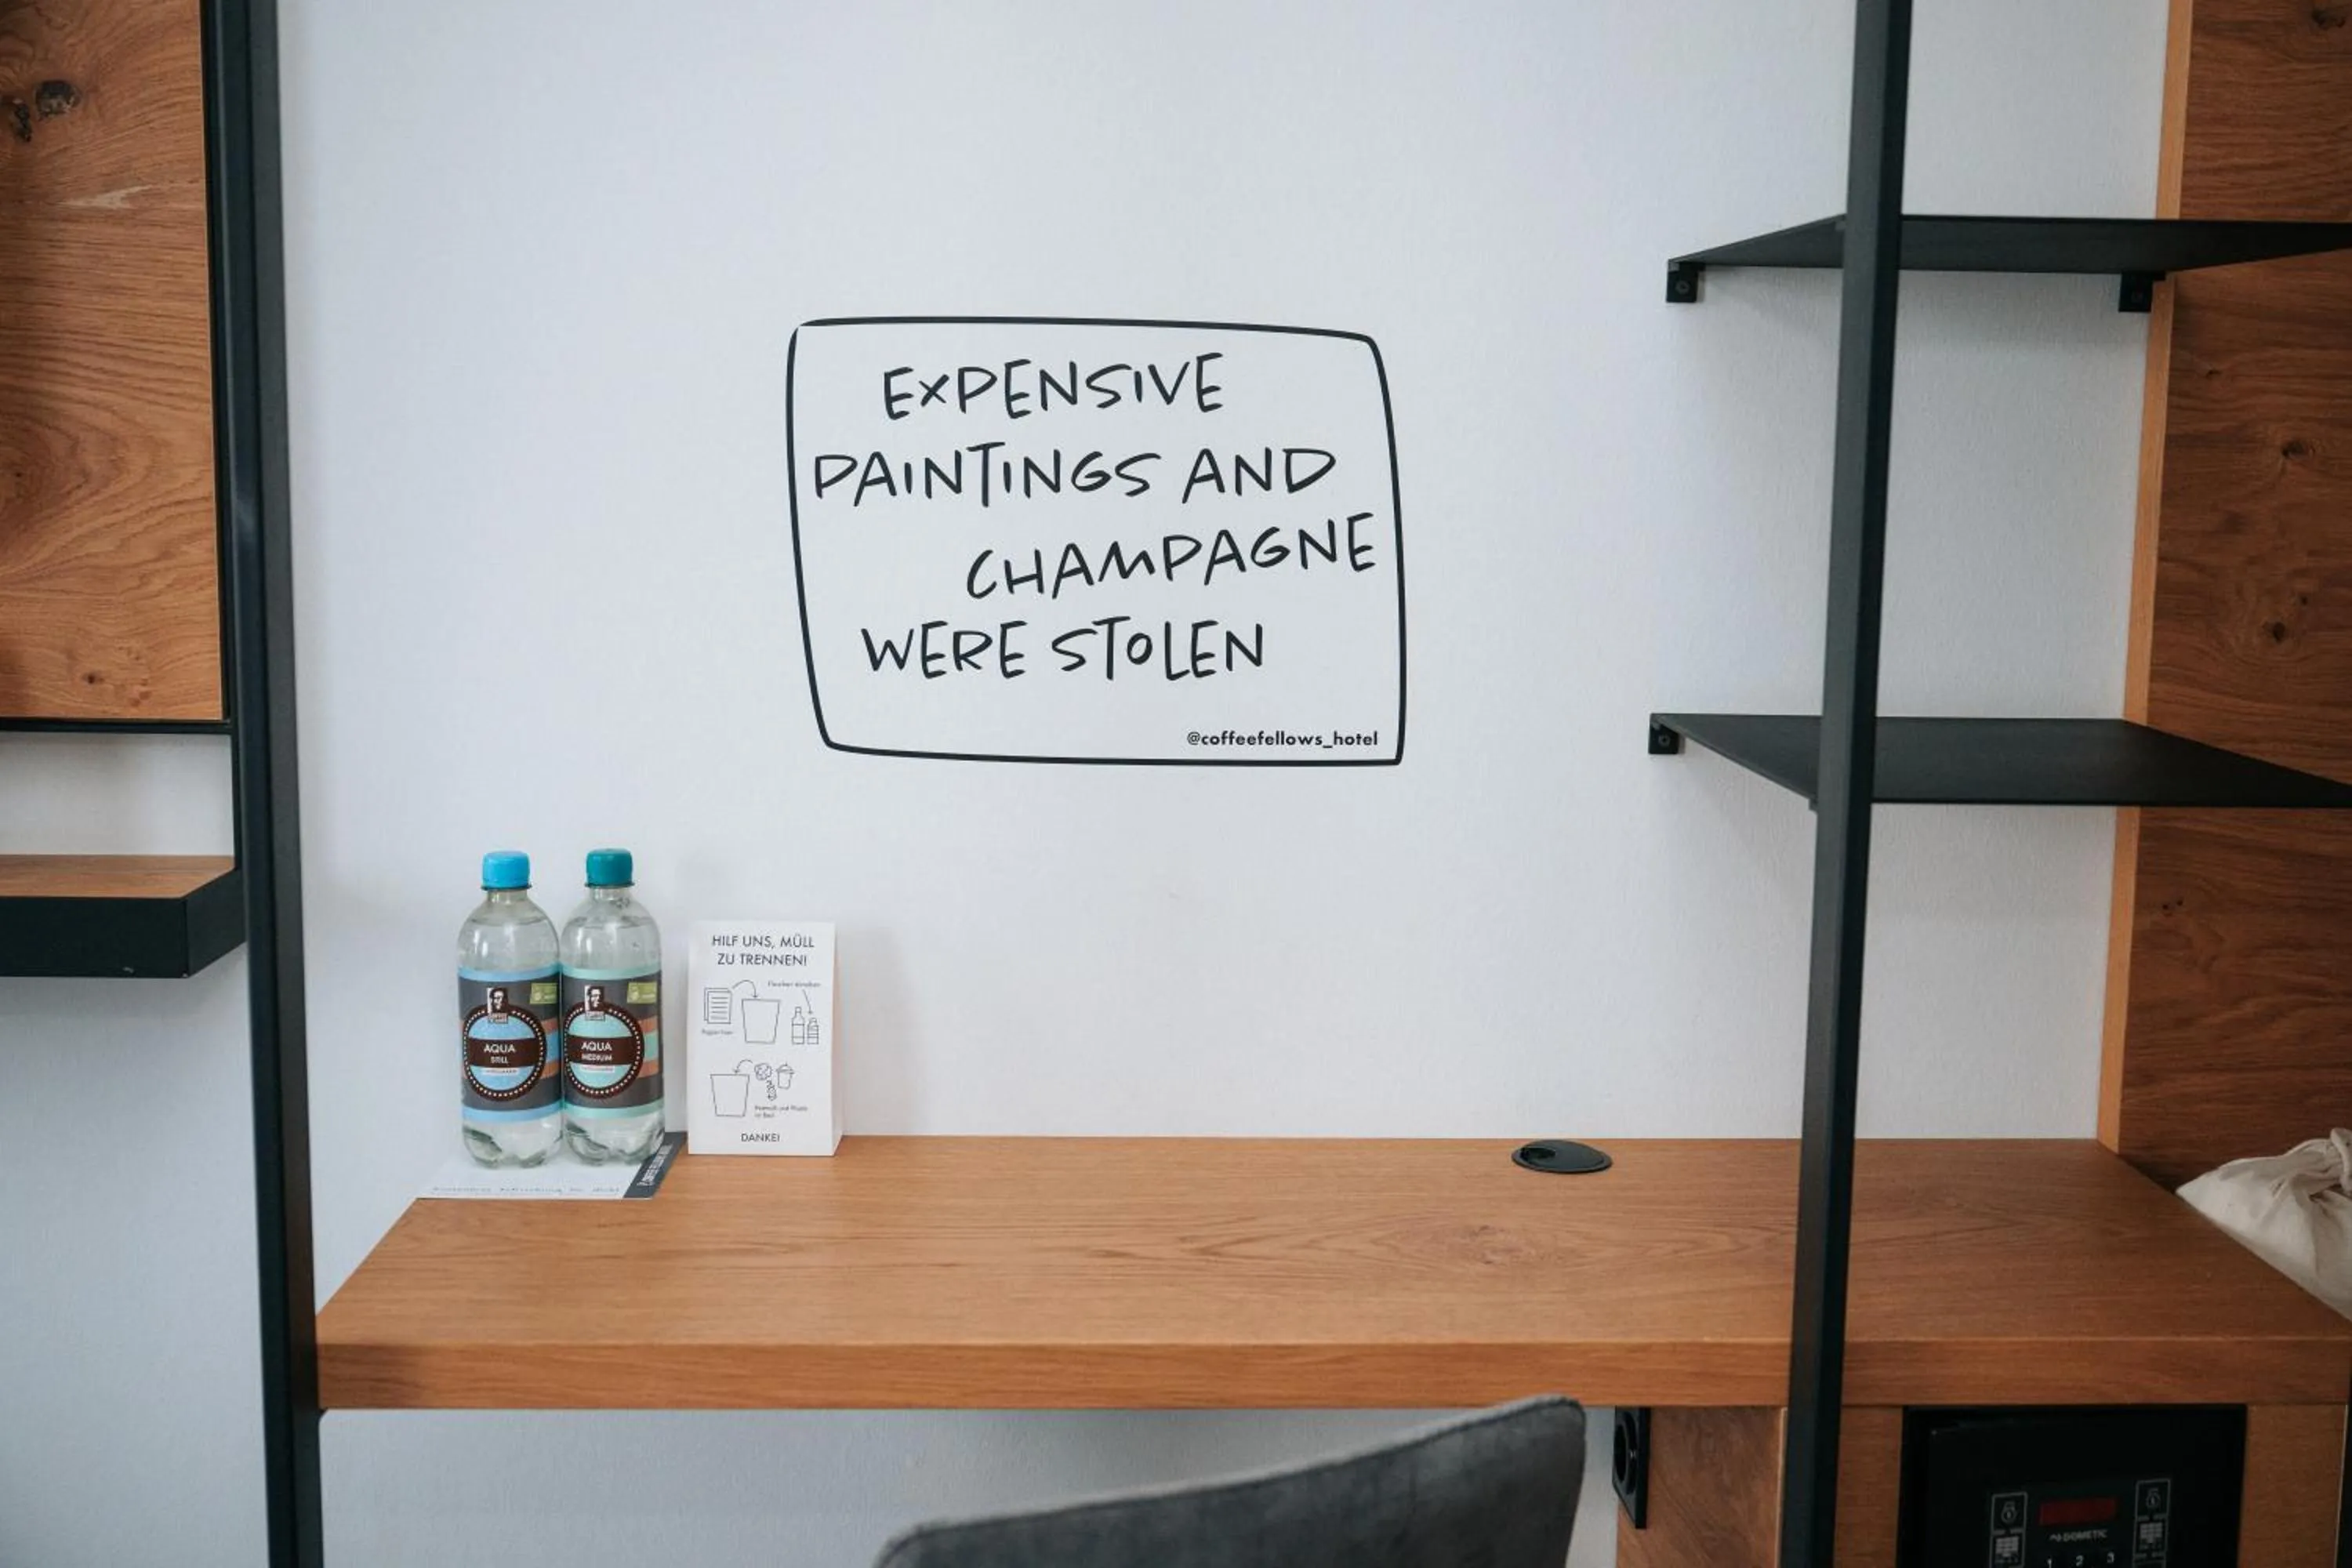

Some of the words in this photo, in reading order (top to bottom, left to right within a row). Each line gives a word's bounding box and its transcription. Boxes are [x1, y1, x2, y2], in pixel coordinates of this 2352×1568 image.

[883, 351, 1224, 421] EXPENSIVE
[814, 441, 1162, 508] PAINTINGS
[1181, 446, 1337, 504] AND
[967, 512, 1377, 600] CHAMPAGNE
[860, 620, 1028, 680] WERE
[1051, 615, 1263, 681] STOLEN
[1186, 730, 1378, 750] @coffeefellows_hotel
[712, 935, 739, 948] HILF
[742, 935, 775, 949] UNS,
[779, 933, 815, 948] MÜLL
[717, 953, 735, 966] ZU
[739, 953, 808, 967] TRENNEN!
[483, 1044, 517, 1054] AQUA
[580, 1040, 613, 1052] AQUA
[741, 1133, 781, 1143] DANKE!
